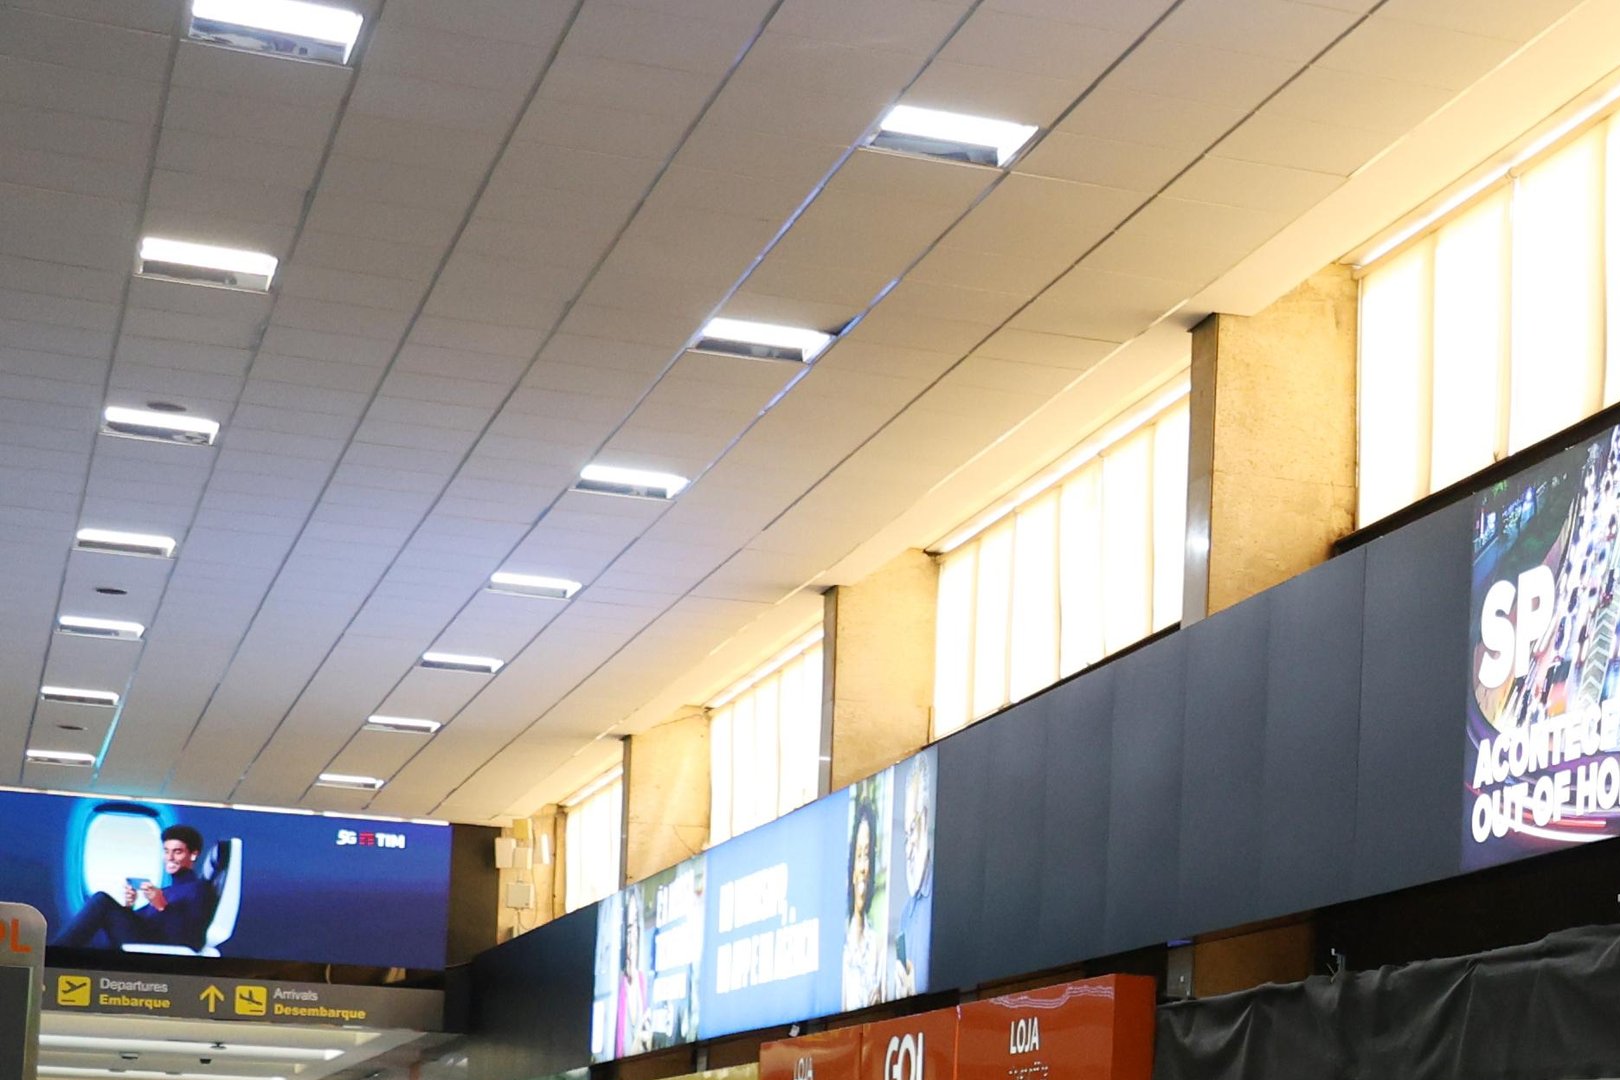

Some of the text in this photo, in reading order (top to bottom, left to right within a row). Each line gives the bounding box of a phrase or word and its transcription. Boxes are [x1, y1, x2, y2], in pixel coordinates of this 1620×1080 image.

[1478, 564, 1556, 689] SP
[1473, 700, 1619, 789] ACONTECE
[1471, 783, 1529, 843] OUT
[1533, 769, 1572, 827] OF
[100, 977, 169, 992] Departures
[273, 987, 319, 1001] Arrivals
[99, 994, 171, 1010] Embarque
[274, 1002, 367, 1021] Desembarque
[1010, 1016, 1040, 1055] LOJA
